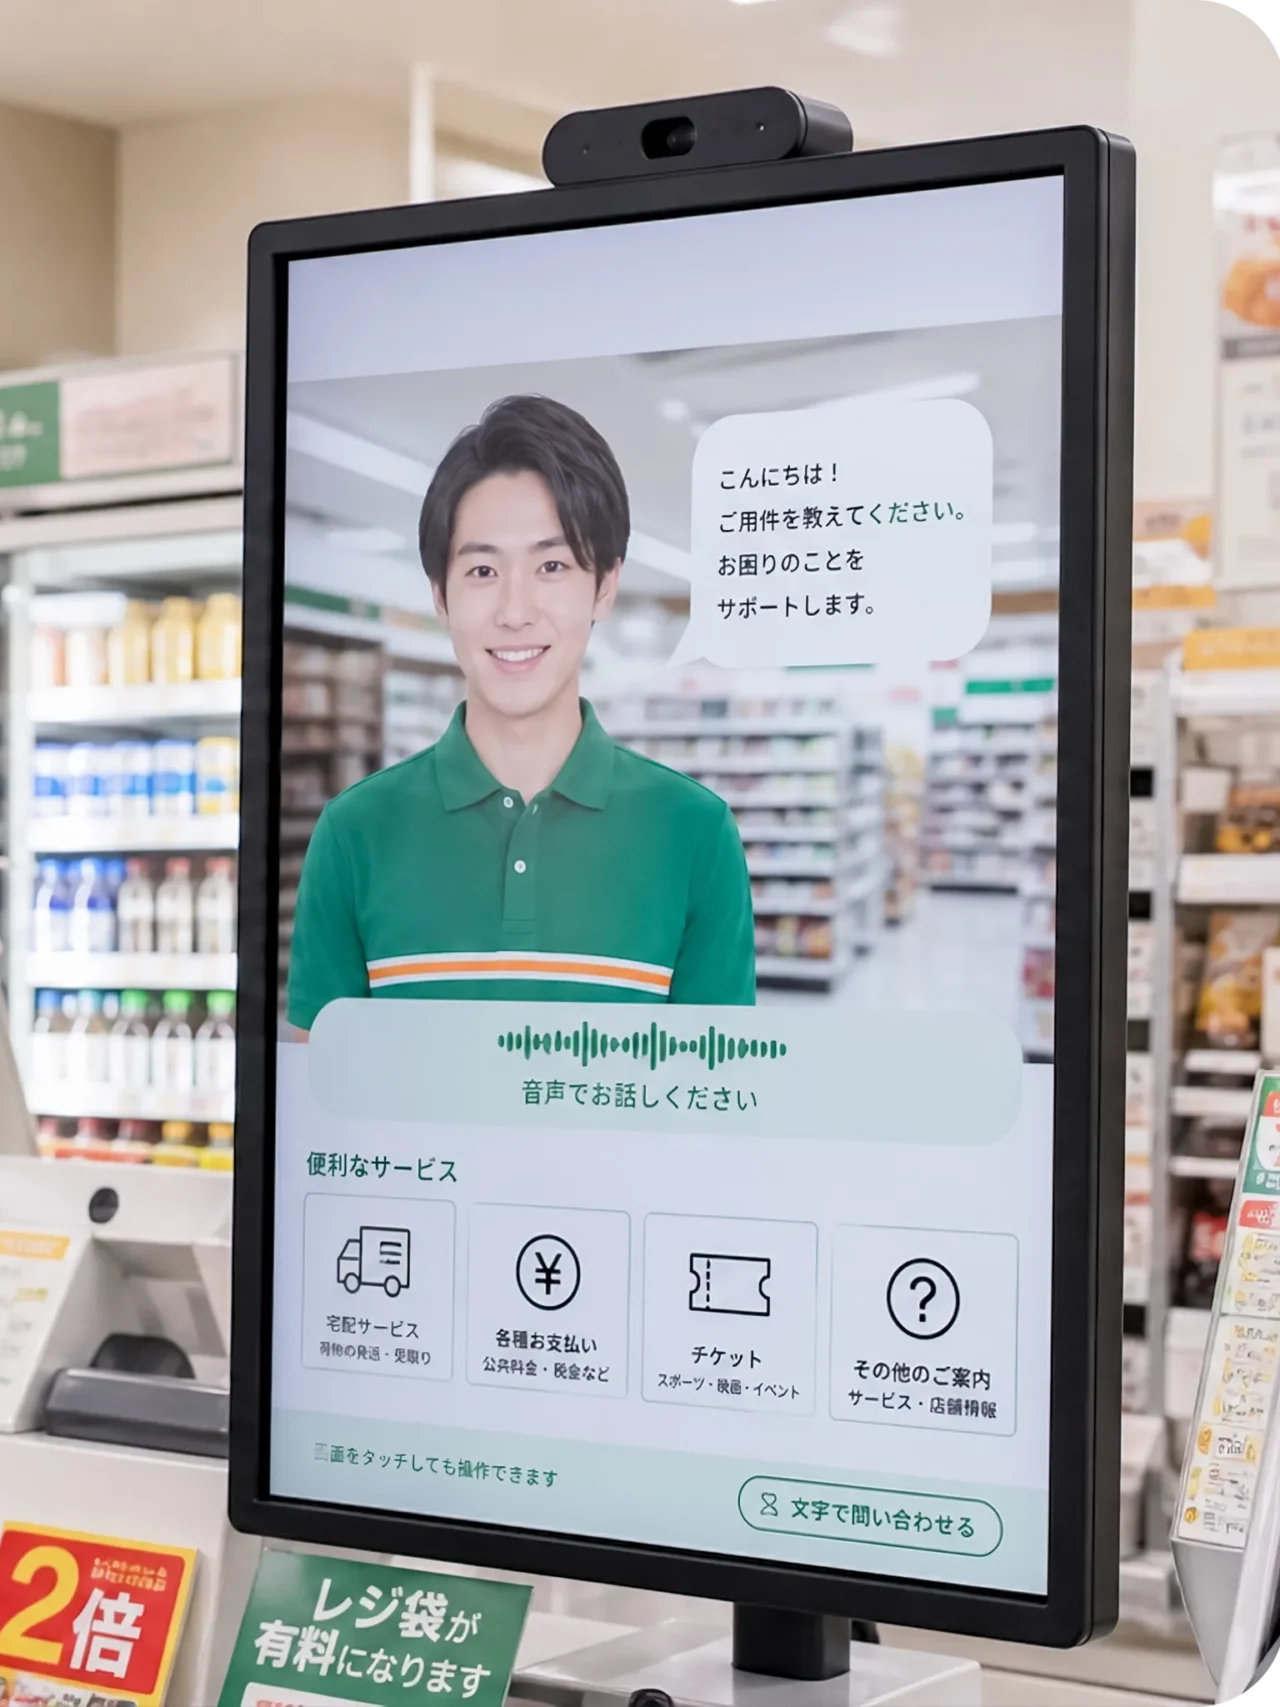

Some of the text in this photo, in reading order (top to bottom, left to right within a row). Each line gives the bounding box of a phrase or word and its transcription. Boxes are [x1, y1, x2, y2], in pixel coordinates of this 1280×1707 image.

[720, 463, 838, 491] こんにちは！
[719, 500, 965, 534] ご用件を教えてください。
[718, 548, 864, 577] お困りのことを
[717, 592, 875, 620] サポートします。
[522, 1078, 757, 1111] 音声でお話しください
[307, 1151, 457, 1182] 便利なサービス
[326, 1315, 419, 1339] 宅配サービス
[692, 1346, 761, 1368] チケット
[854, 1360, 990, 1390] その他のご案内
[791, 1497, 974, 1538] 文字で問い合わせる
[313, 1578, 482, 1643] レジ袋が
[254, 1619, 491, 1699] 有料になります
